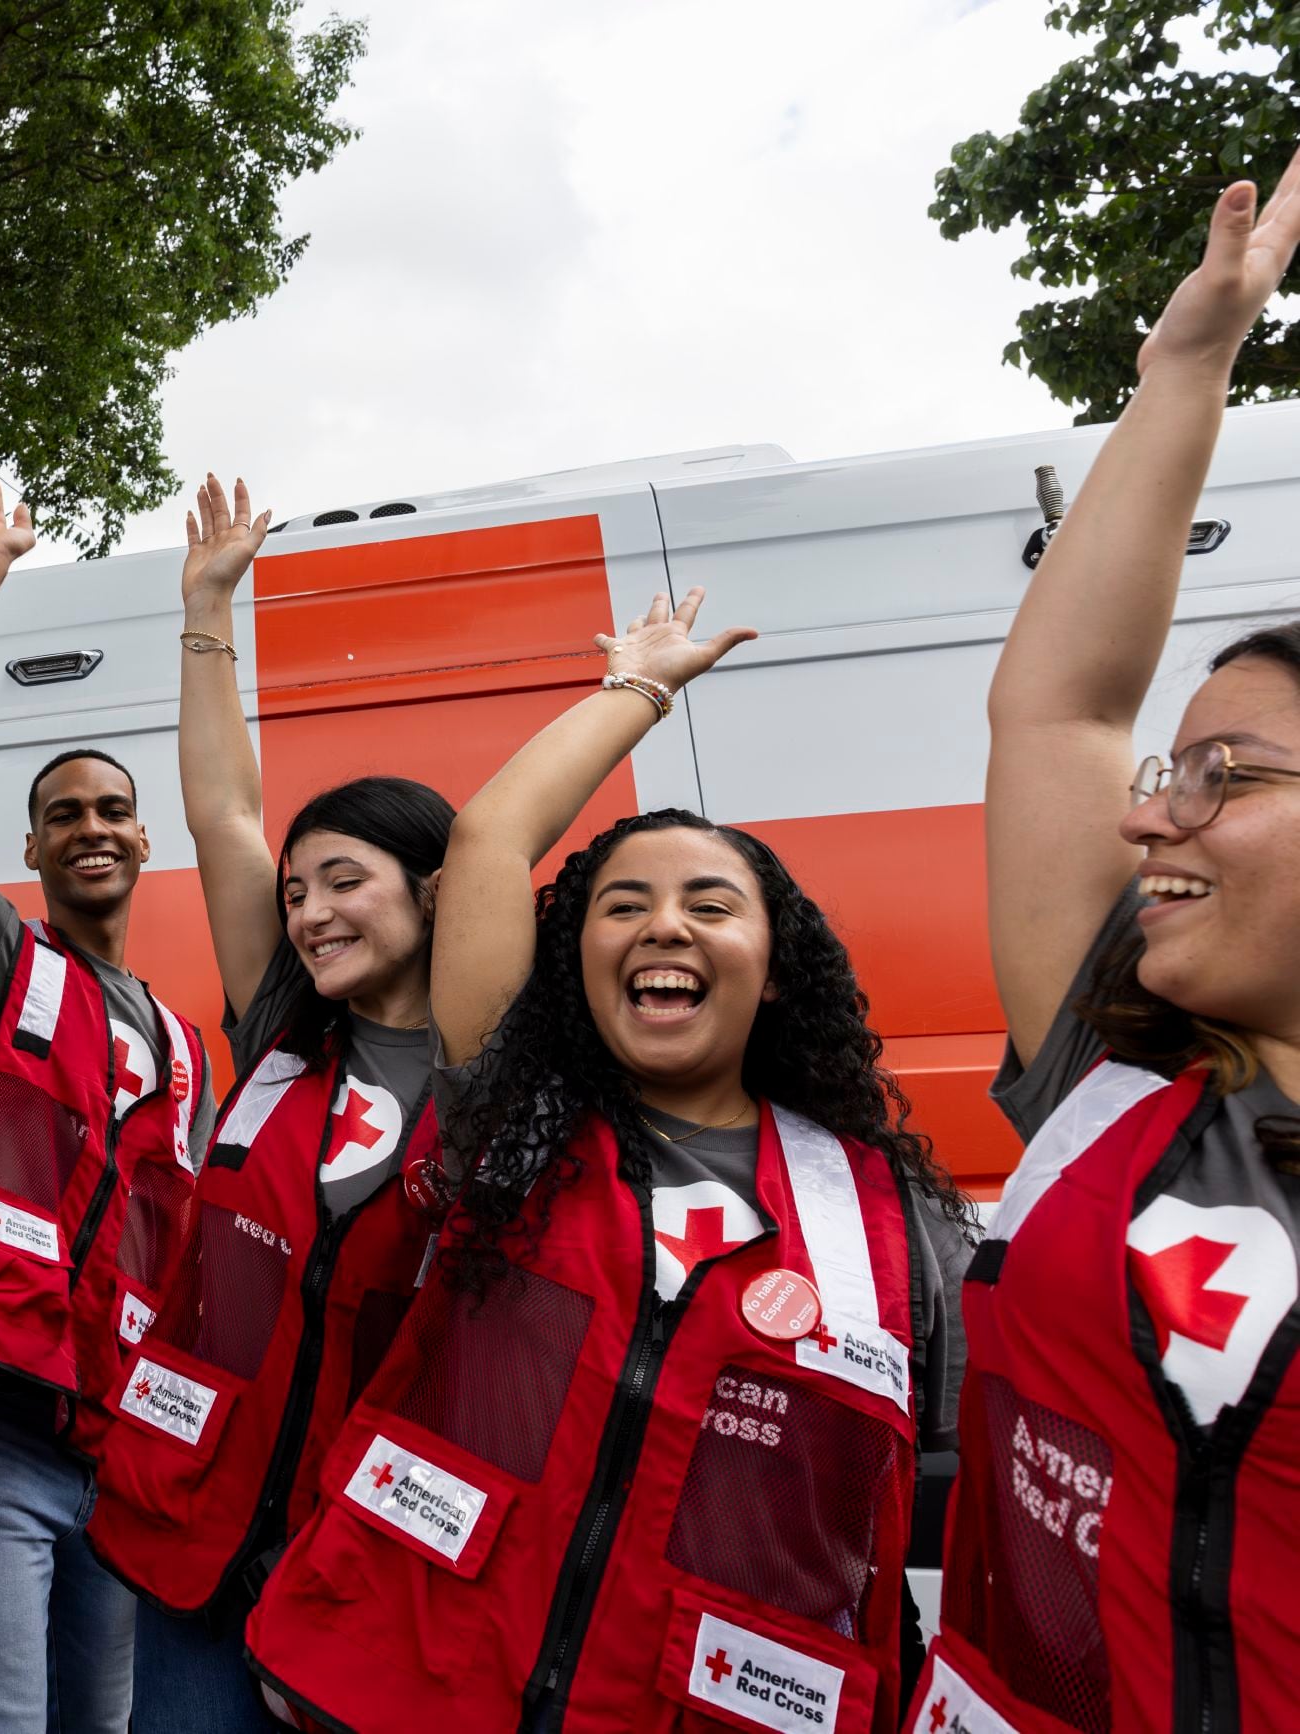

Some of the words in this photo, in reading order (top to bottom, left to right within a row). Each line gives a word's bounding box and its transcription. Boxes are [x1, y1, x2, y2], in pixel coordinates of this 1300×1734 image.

[5, 1218, 51, 1240] American
[5, 1226, 24, 1238] Red
[25, 1233, 52, 1248] Cross
[743, 1299, 760, 1312] Yo
[754, 1271, 782, 1300] hablo
[760, 1280, 797, 1322] Español
[844, 1346, 872, 1369] Red
[150, 1395, 167, 1412] Red
[169, 1405, 197, 1426] Cross
[155, 1384, 201, 1414] American
[391, 1488, 419, 1511] Red
[419, 1505, 460, 1537] Cross
[398, 1476, 467, 1523] American
[1012, 1457, 1071, 1538] Red
[736, 1676, 771, 1702] Red
[774, 1691, 824, 1724] Cross
[740, 1659, 826, 1705] American
